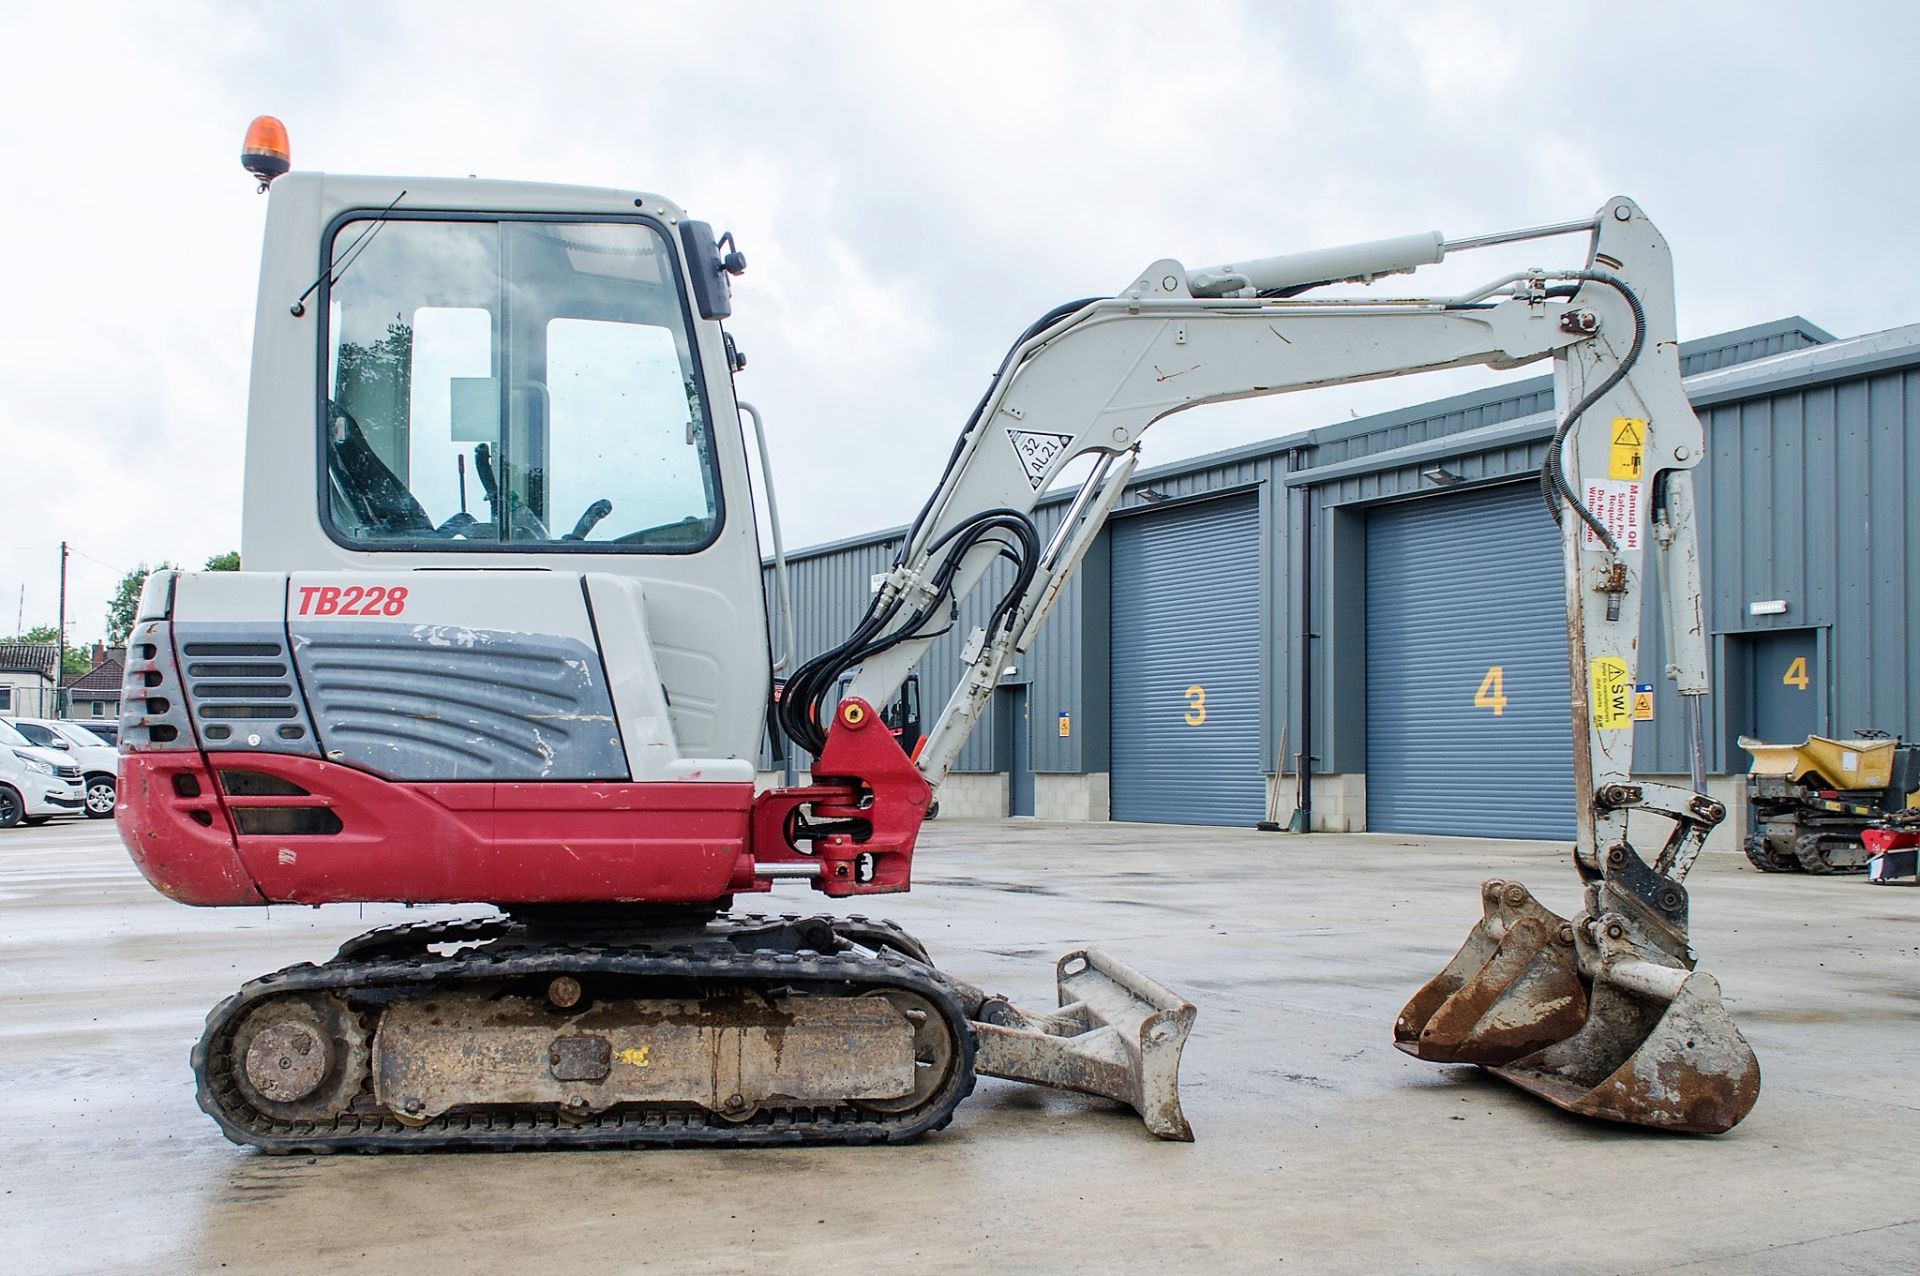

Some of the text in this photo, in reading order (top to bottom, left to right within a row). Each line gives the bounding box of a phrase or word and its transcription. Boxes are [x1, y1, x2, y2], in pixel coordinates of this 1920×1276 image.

[1022, 438, 1040, 456] 32
[1598, 489, 1604, 501] Do
[1616, 493, 1625, 521] Safety
[1608, 495, 1616, 536] Required
[1628, 485, 1638, 548] Manual QH
[298, 586, 408, 616] TB228
[1474, 666, 1507, 715] 4
[1783, 657, 1809, 690] 4
[1184, 685, 1206, 726] 3
[1611, 684, 1625, 721] SWL
